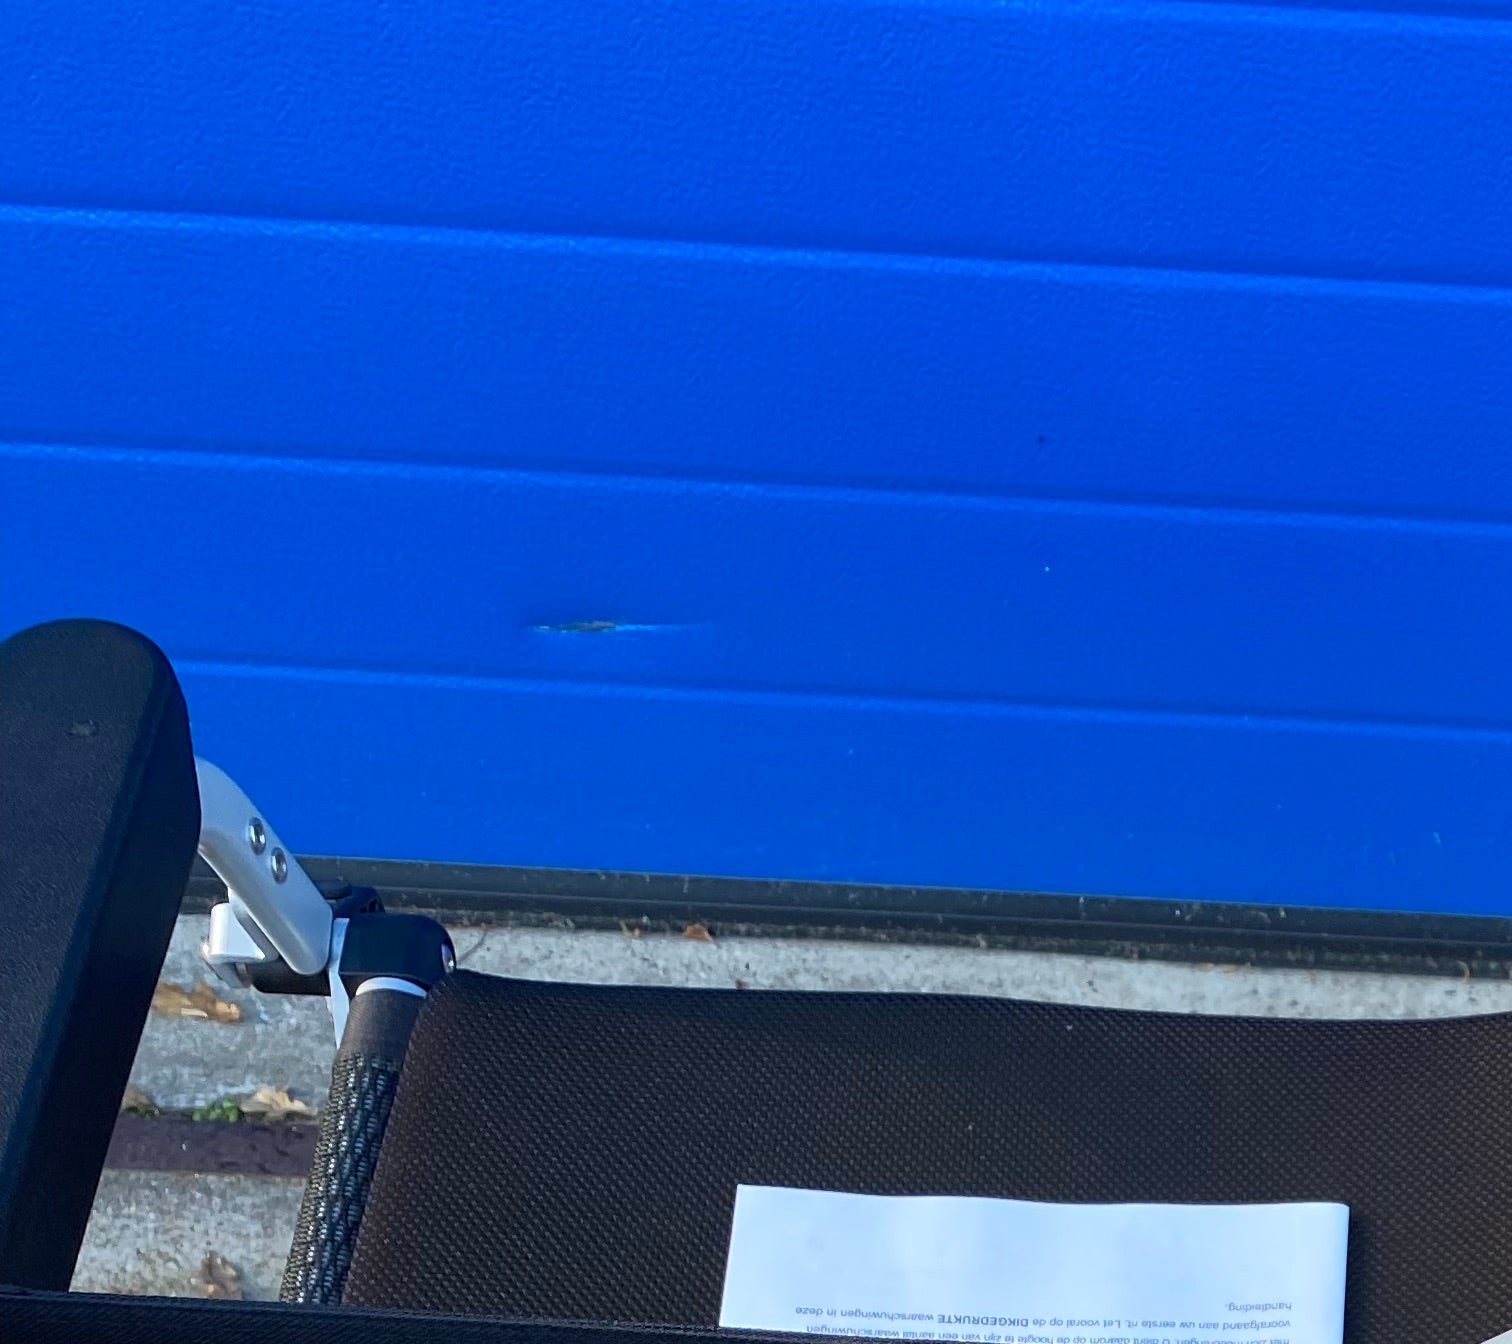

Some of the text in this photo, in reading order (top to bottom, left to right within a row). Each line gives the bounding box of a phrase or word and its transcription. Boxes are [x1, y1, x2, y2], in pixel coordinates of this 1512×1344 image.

[1225, 1302, 1292, 1312] handleiding.
[796, 1307, 823, 1317] deze
[827, 1309, 836, 1317] in
[841, 1309, 933, 1322] waarschuwingen
[937, 1314, 1029, 1327] DIKGEDRUKTE
[1032, 1318, 1045, 1328] de
[1049, 1317, 1063, 1326] op
[1066, 1319, 1099, 1328] vooral
[1104, 1319, 1120, 1328] Let
[1142, 1320, 1175, 1328] eerste
[1199, 1321, 1219, 1329] aan
[1222, 1320, 1291, 1331] voorafgaand
[807, 1325, 900, 1338] waarschuwingen
[938, 1332, 958, 1340] een
[962, 1333, 980, 1341] van
[984, 1333, 1001, 1342] zijn
[1005, 1335, 1014, 1343] te
[1018, 1334, 1053, 1344] hoogte
[1057, 1336, 1070, 1344] de
[1073, 1336, 1086, 1344] op
[1090, 1337, 1130, 1344] daarom
